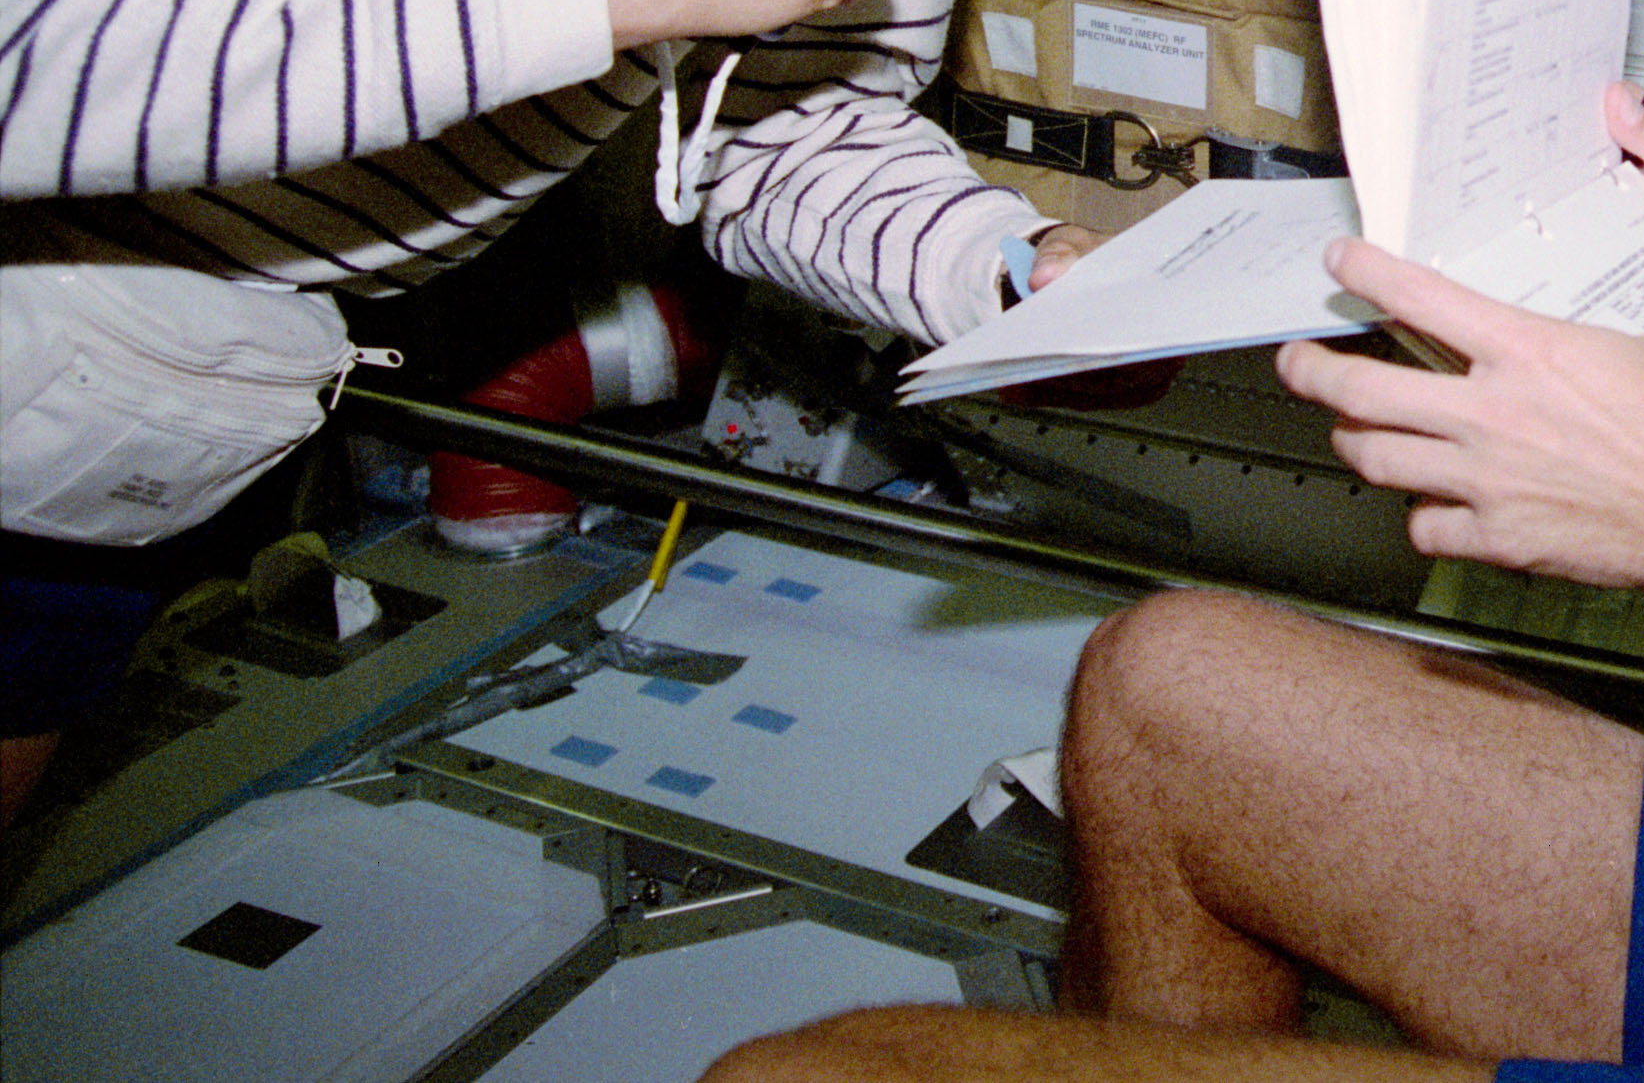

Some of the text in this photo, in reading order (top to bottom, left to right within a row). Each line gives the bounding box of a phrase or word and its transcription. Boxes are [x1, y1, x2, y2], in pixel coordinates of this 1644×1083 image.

[1076, 28, 1205, 60] SPECTRUM ANALYZER UNIT
[1090, 19, 1110, 31] RME
[1173, 35, 1187, 46] RF
